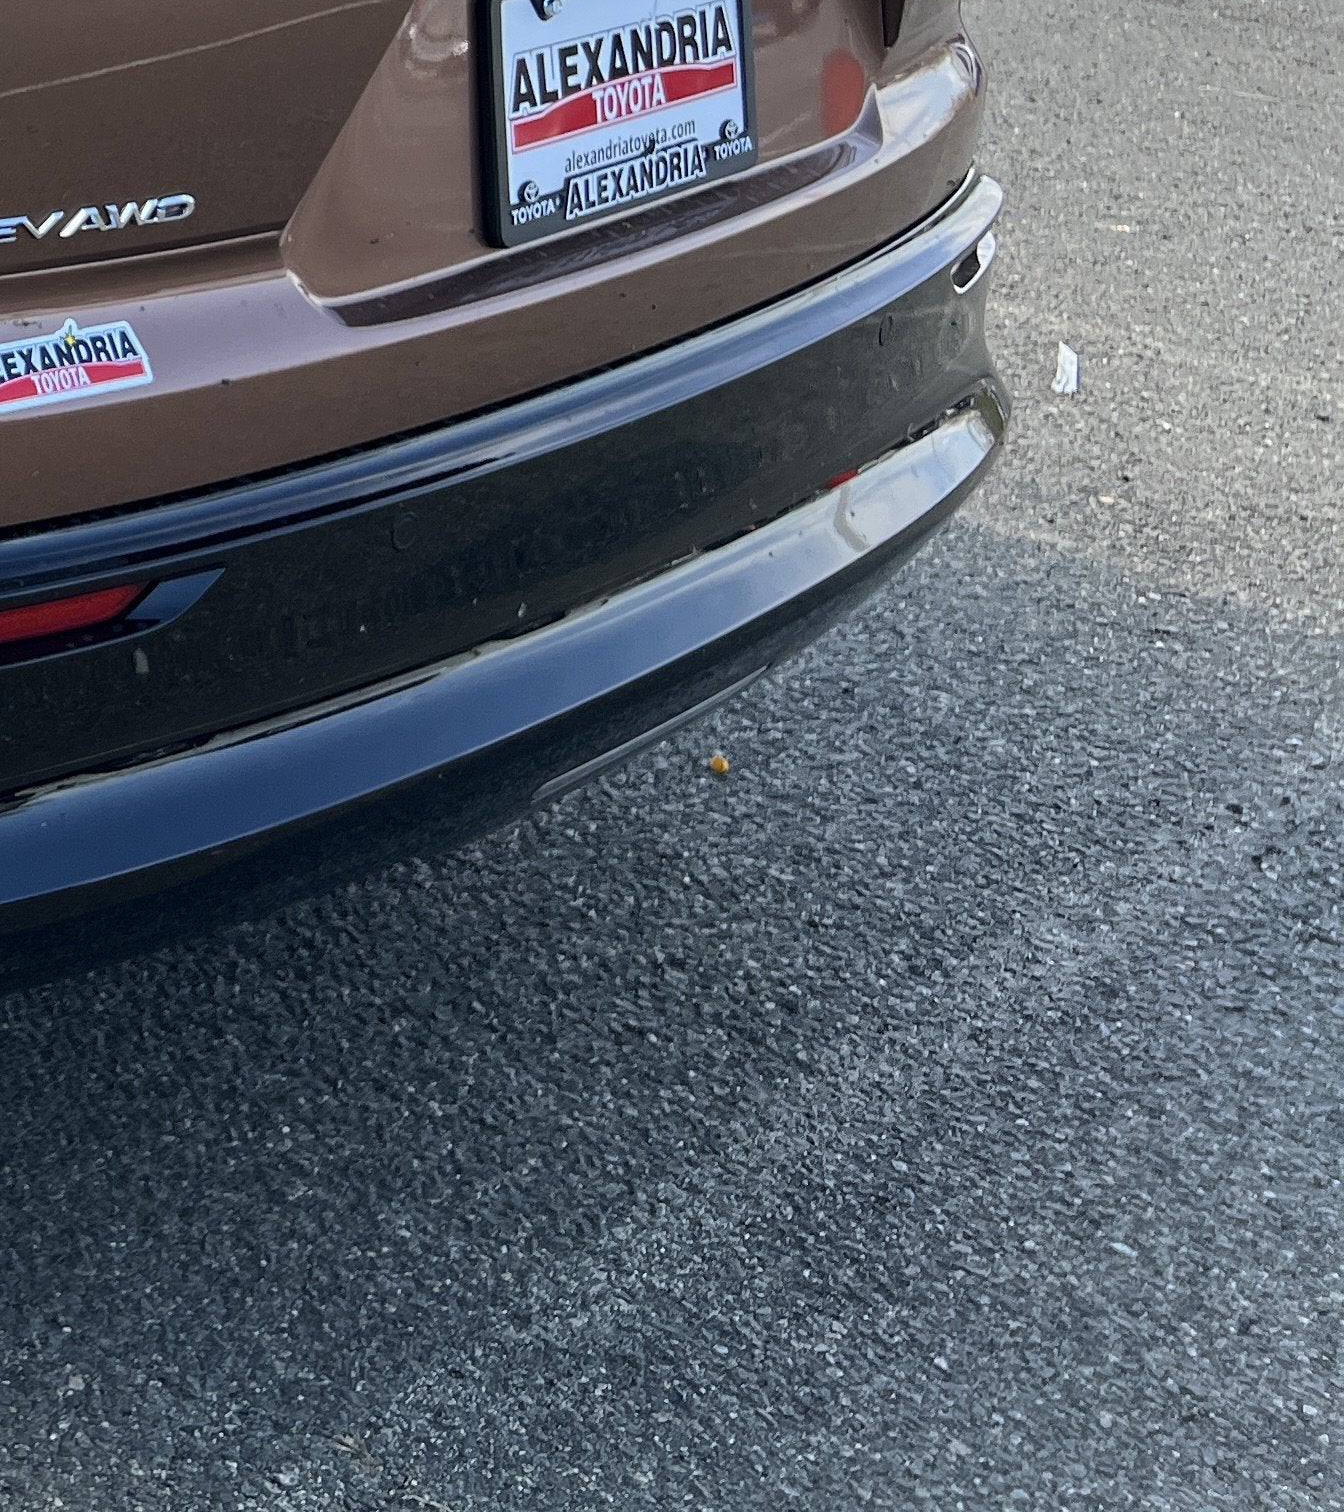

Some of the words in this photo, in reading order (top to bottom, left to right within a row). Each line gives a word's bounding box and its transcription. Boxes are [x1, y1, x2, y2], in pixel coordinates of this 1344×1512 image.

[512, 5, 733, 113] ALEXANDRIA
[592, 73, 667, 124] TOYOTA
[564, 118, 696, 173] alexandriatoyota.com
[713, 136, 753, 161] TOYOTA
[567, 142, 706, 220] ALEXANDRIA
[511, 198, 556, 226] TOYOTA
[30, 365, 91, 396] TOYOTA
